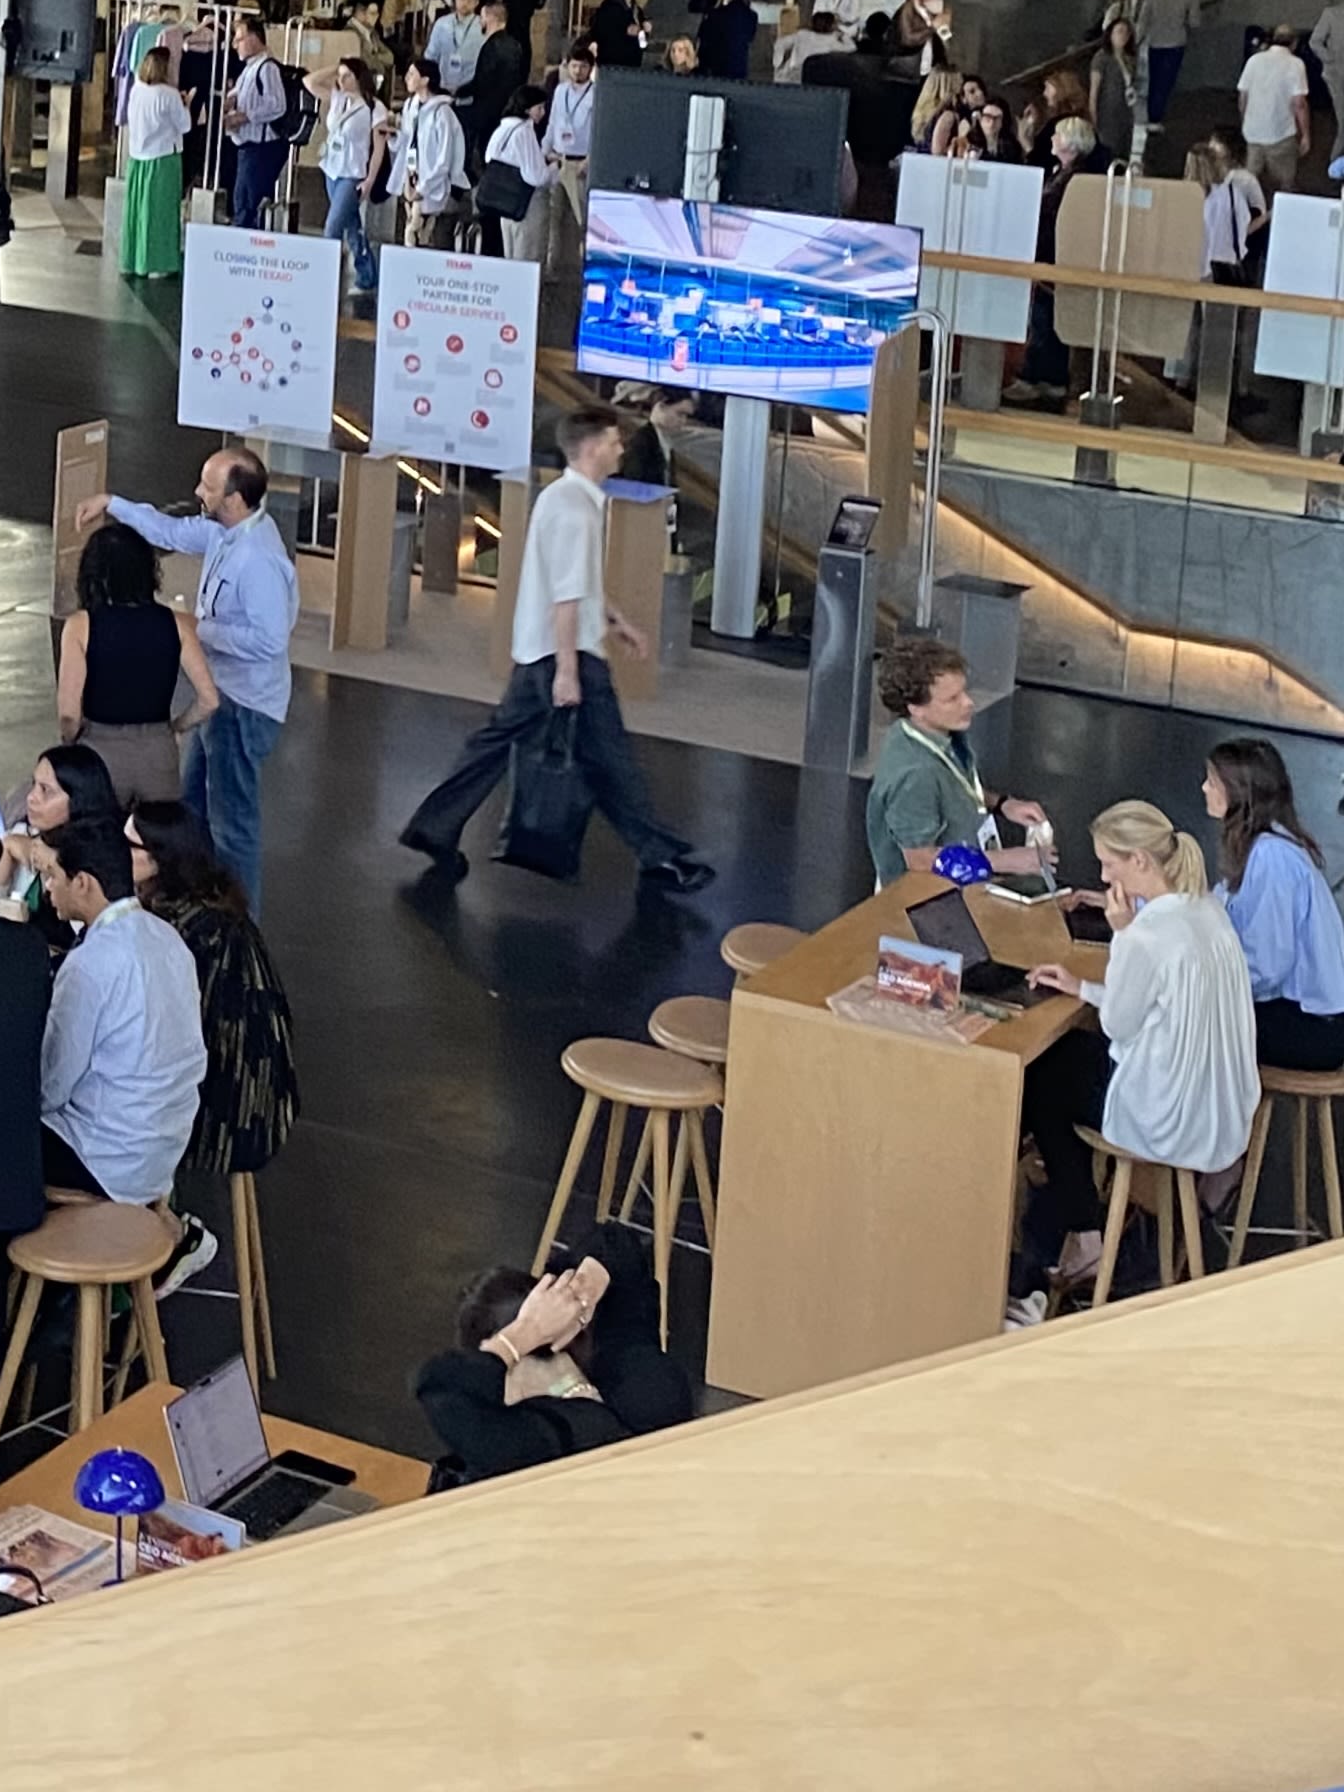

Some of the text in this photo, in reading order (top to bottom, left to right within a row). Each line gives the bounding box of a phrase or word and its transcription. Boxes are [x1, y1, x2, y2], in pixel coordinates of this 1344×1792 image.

[214, 250, 309, 271] CLOSING THE LOOP
[229, 266, 293, 282] WITH TEXAID
[417, 275, 499, 295] YOUR ONE-STOP
[423, 289, 492, 307] PARTNER FOR
[408, 300, 506, 322] CIRCULAR SERVICES
[138, 1541, 160, 1557] CEO
